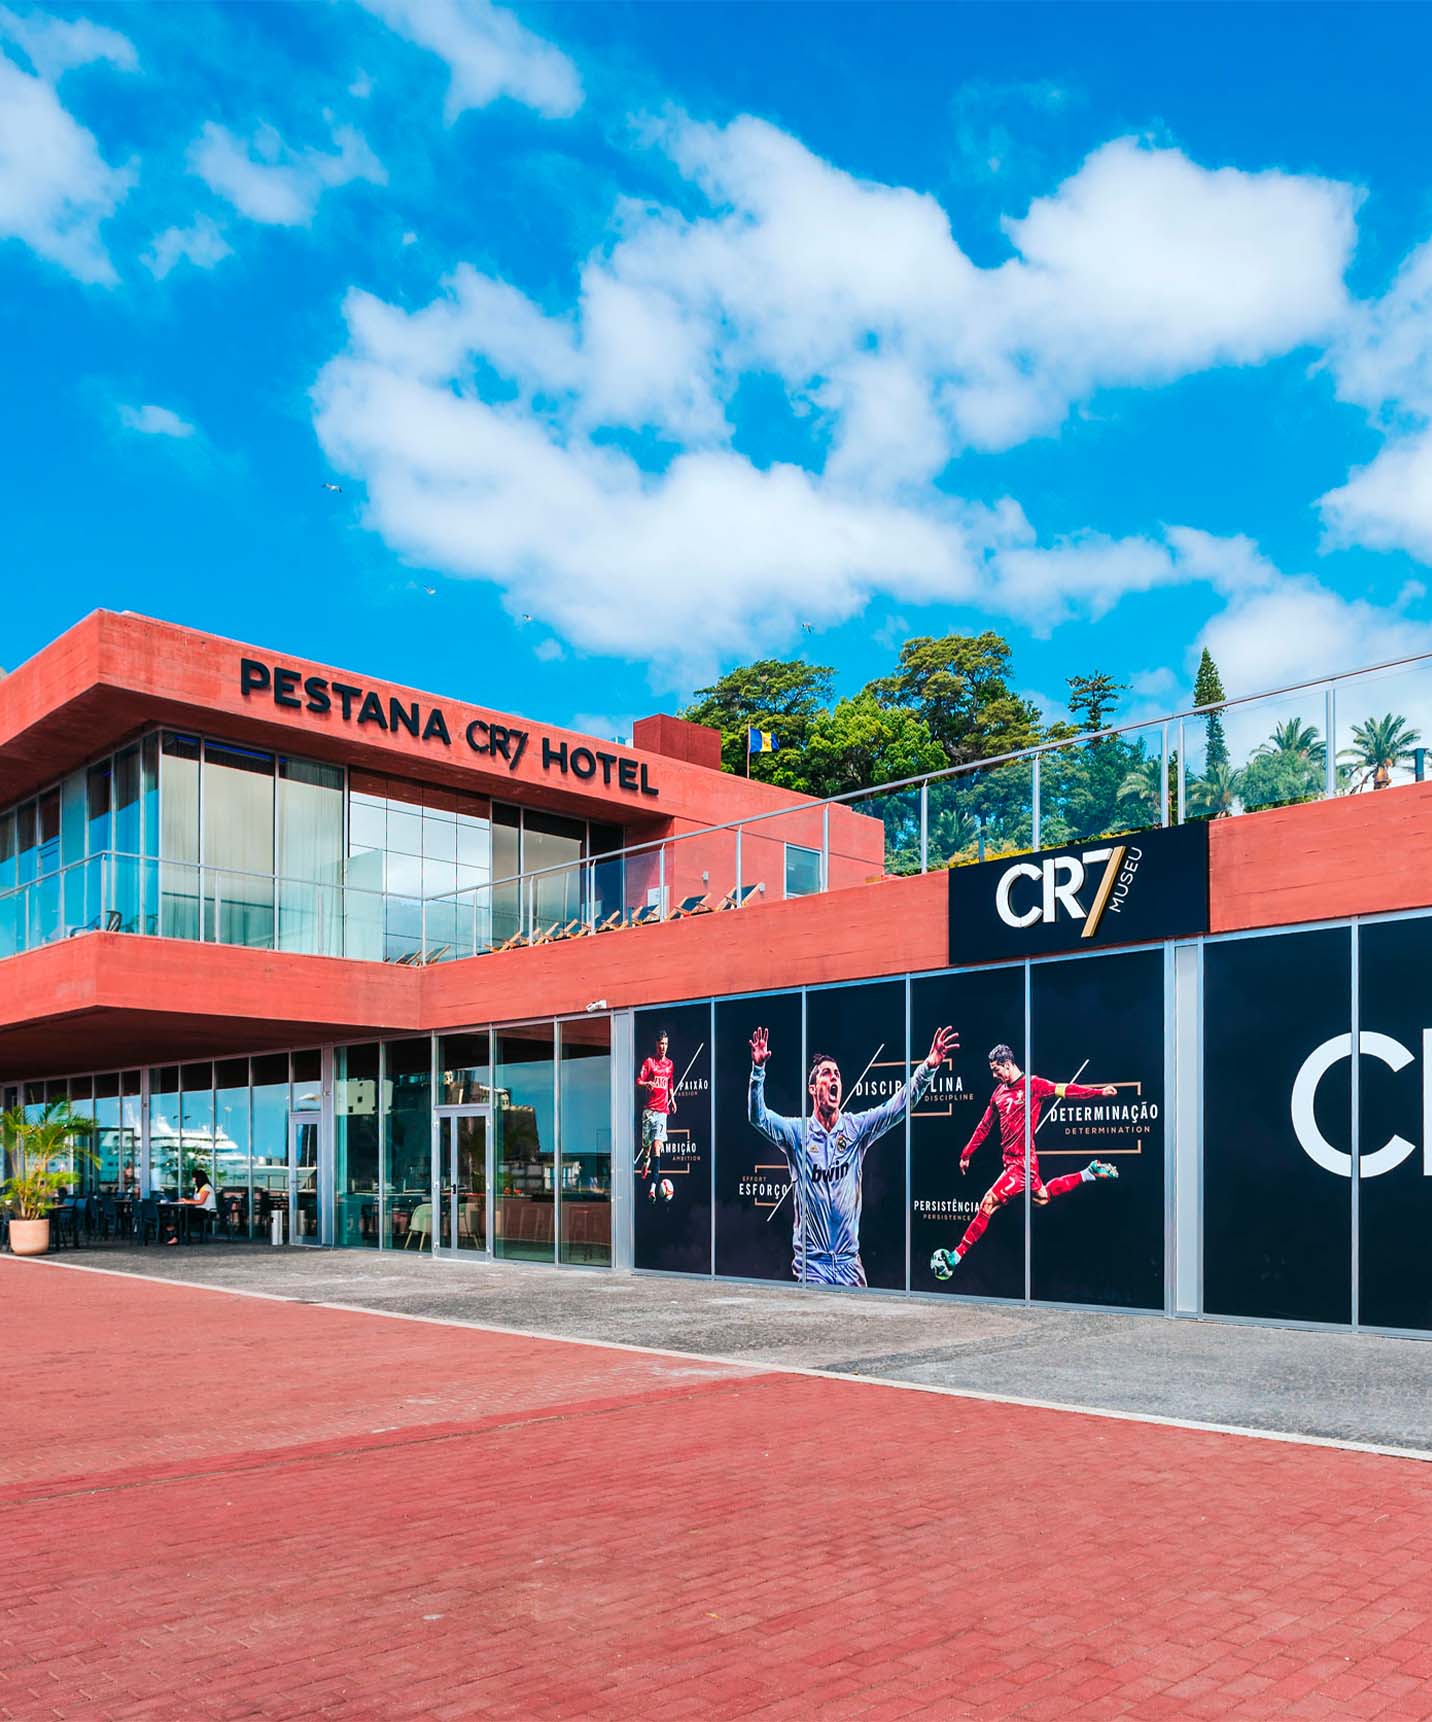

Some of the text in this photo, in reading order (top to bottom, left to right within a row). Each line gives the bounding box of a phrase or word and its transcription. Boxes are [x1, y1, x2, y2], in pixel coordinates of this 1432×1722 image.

[241, 658, 659, 796] PESTANA CR7 HOTEL
[1109, 846, 1143, 913] MUSEU
[995, 845, 1127, 938] CR7
[924, 1093, 974, 1102] DISCIPLINE
[1290, 1028, 1432, 1179] C
[1050, 1101, 1159, 1123] DETERMINAÇÃO
[1064, 1126, 1151, 1135] DETERMINATION
[660, 1140, 697, 1155] AMBIÇÃO
[811, 1159, 849, 1182] bwin
[739, 1183, 788, 1199] ESFORÇO
[914, 1198, 980, 1212] PERSISTÊNCIA
